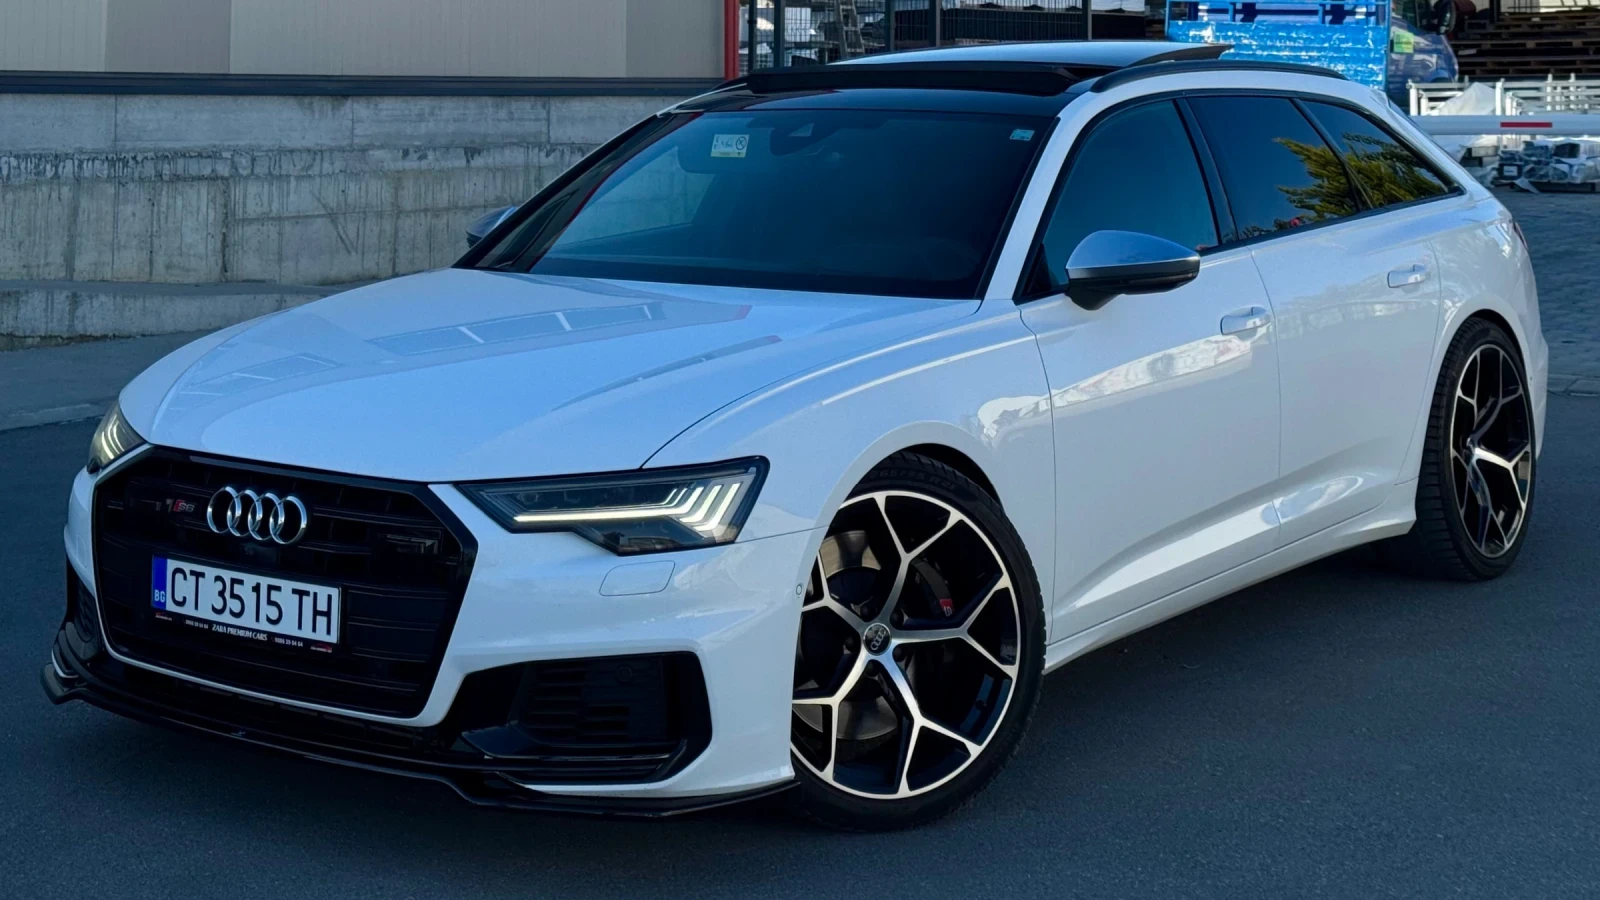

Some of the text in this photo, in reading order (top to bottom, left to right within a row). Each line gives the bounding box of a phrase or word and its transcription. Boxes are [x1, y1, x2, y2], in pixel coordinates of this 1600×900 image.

[154, 589, 166, 603] BG
[171, 567, 333, 636] CT 3515 TH
[211, 623, 227, 634] ZARA
[227, 626, 253, 639] PREMIUM
[252, 631, 268, 641] CARS
